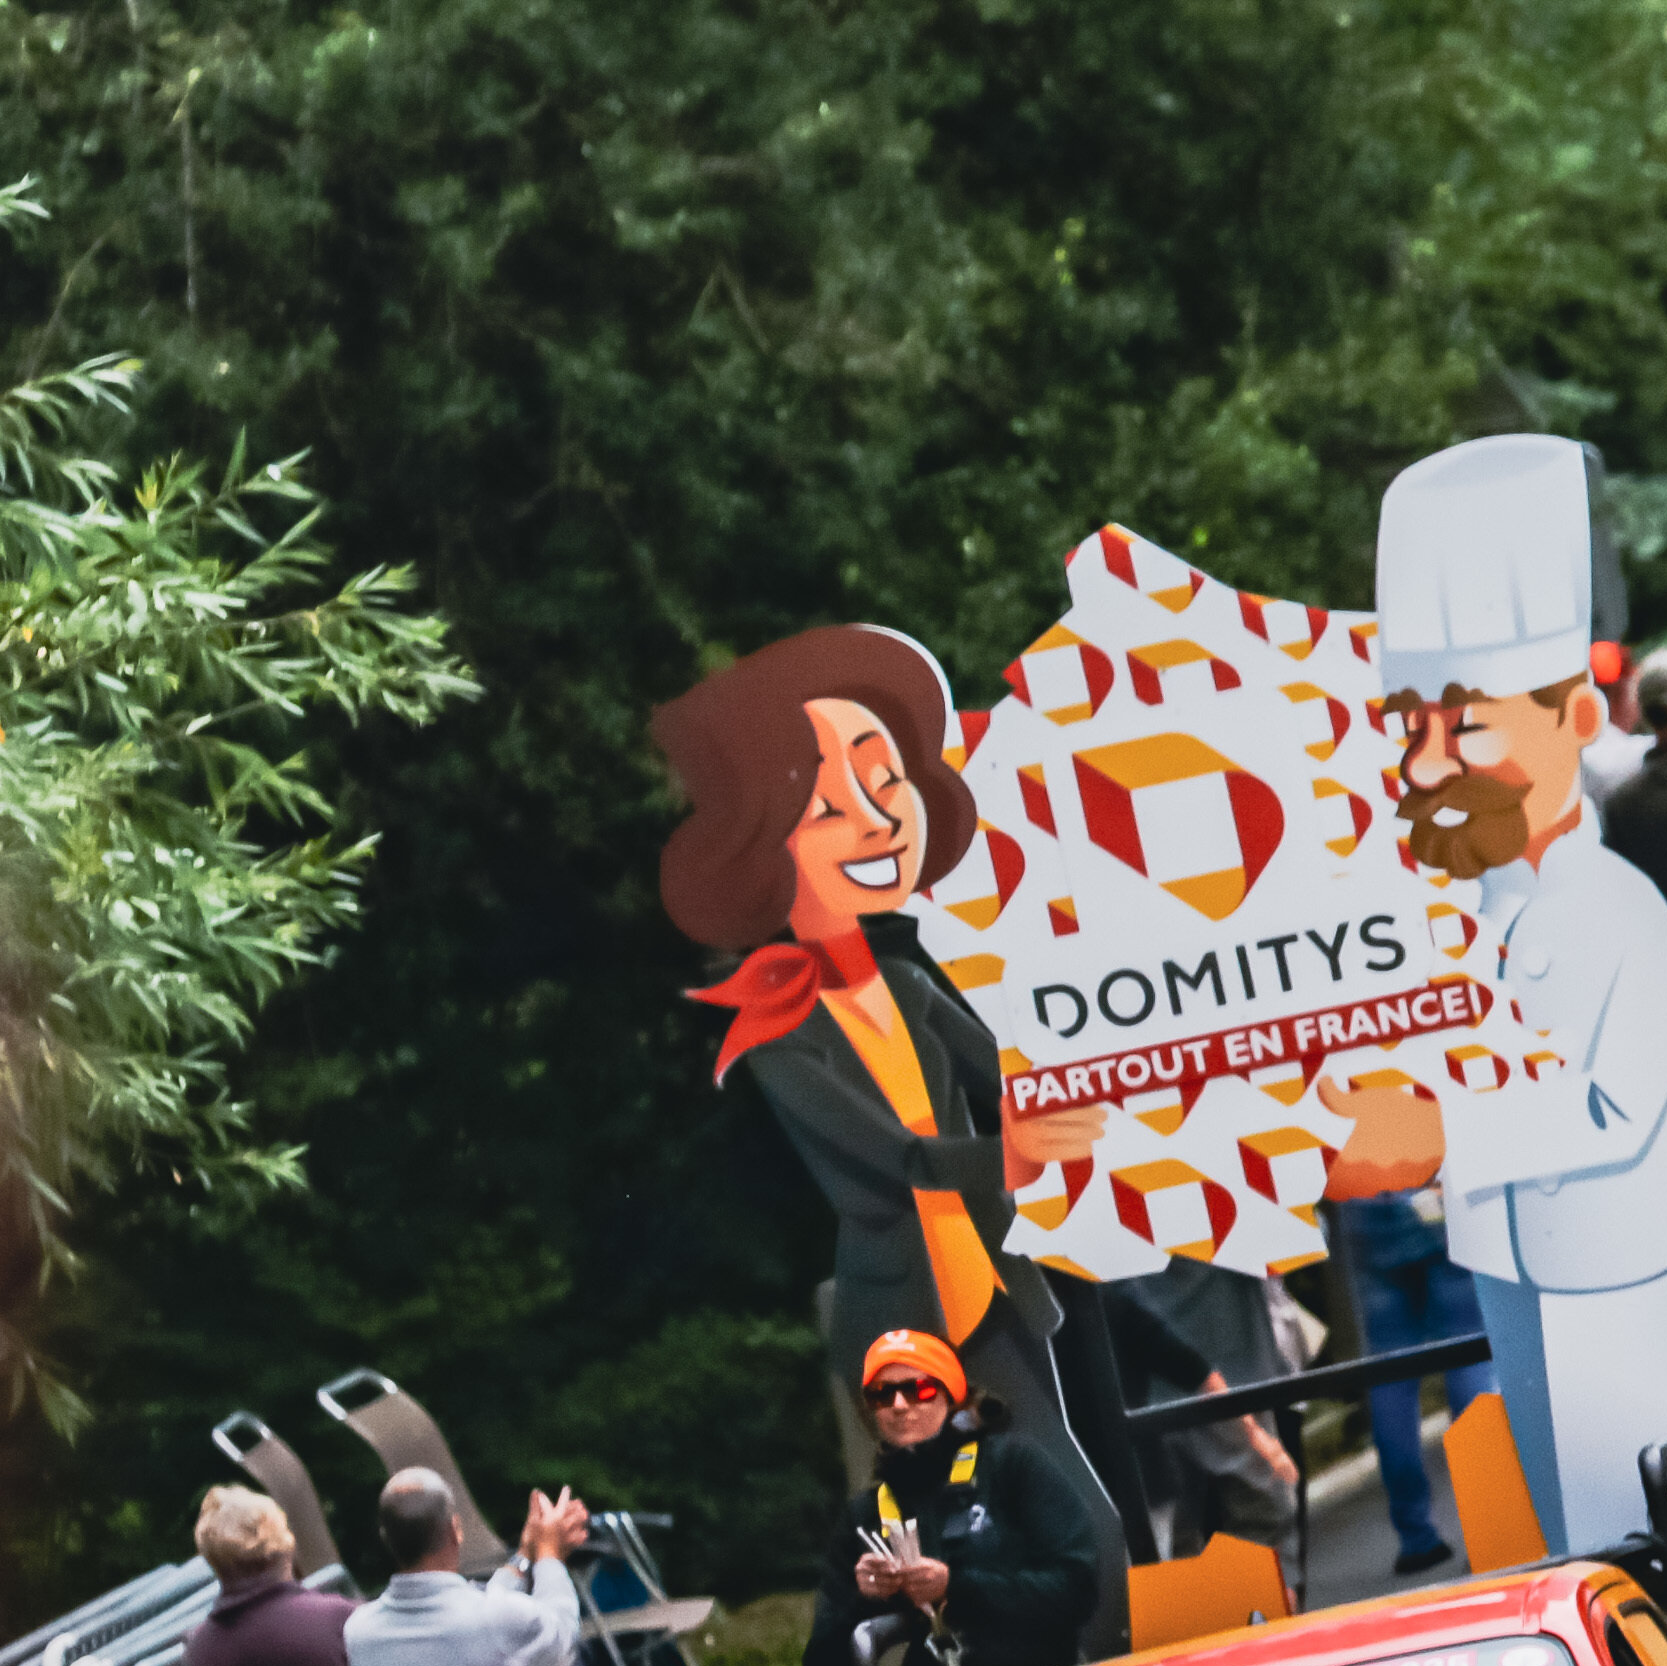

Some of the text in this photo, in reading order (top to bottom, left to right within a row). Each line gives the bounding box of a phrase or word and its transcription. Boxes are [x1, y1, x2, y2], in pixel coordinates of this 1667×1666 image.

[1032, 914, 1407, 1039] DOMITYS
[1013, 988, 1468, 1111] PARTOUT EN FRANCE
